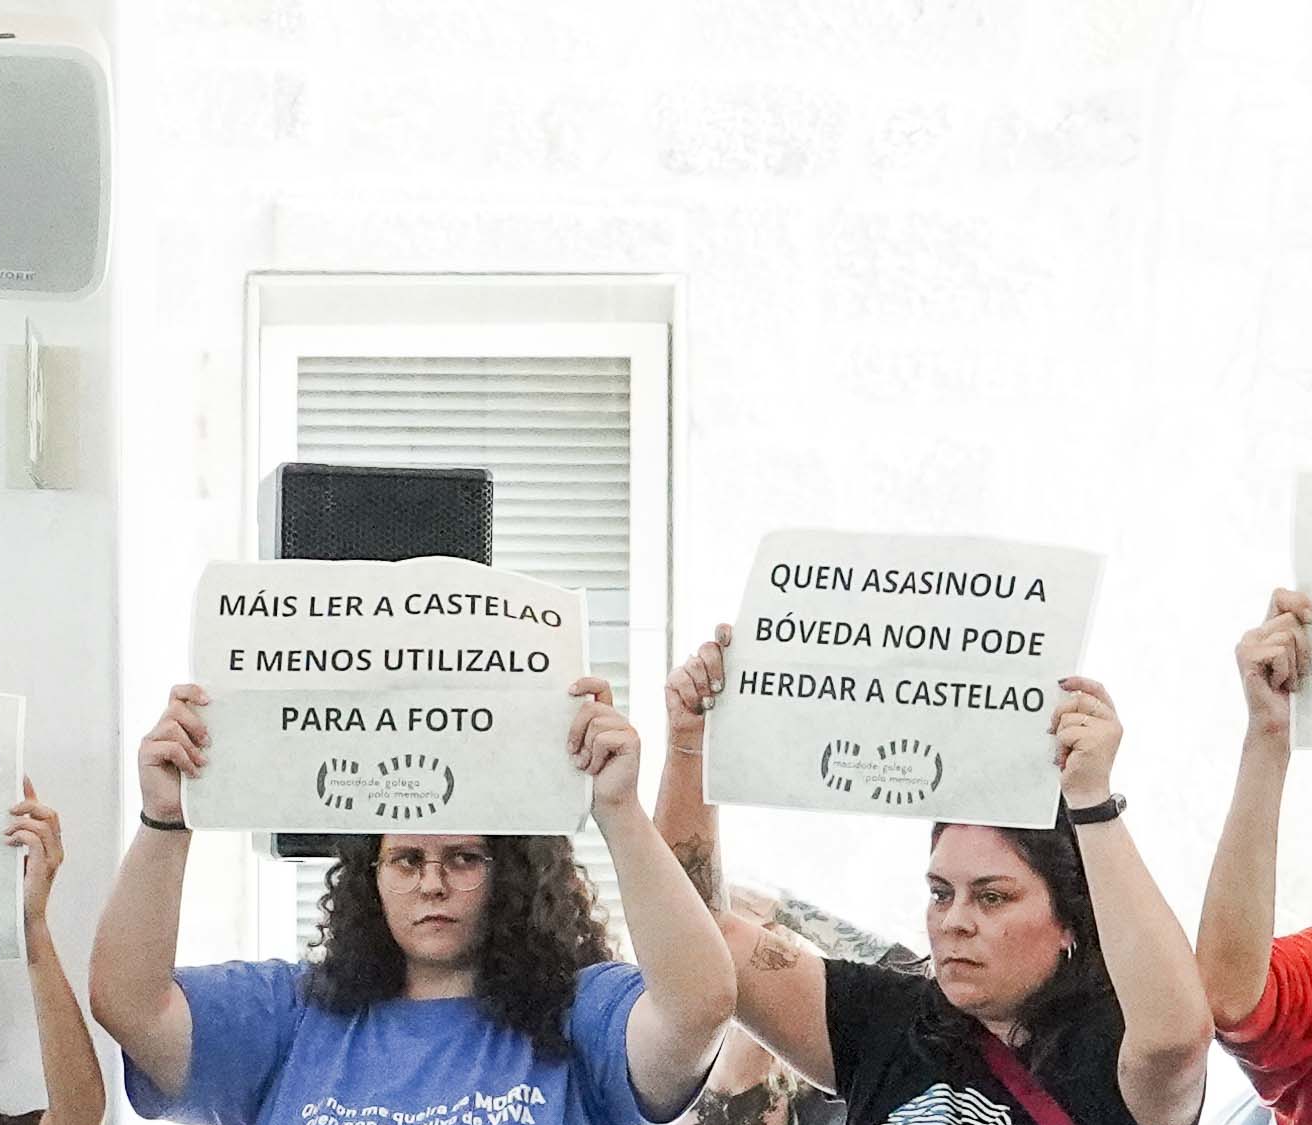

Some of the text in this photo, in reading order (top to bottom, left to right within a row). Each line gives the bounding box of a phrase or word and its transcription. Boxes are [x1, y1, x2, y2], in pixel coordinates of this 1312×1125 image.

[770, 563, 1046, 603] QUEN ASASINOU A
[219, 589, 562, 628] MÁIS LER A CASTELAO
[755, 611, 1045, 656] BÓVEDA NON PODE
[229, 648, 550, 673] E MENOS UTILIZALO
[739, 670, 1044, 713] HERDAR A CASTELAO
[282, 706, 493, 732] PARA A FOTO
[326, 1097, 357, 1118] non
[360, 1106, 389, 1117] me
[475, 1083, 546, 1112] MORTA
